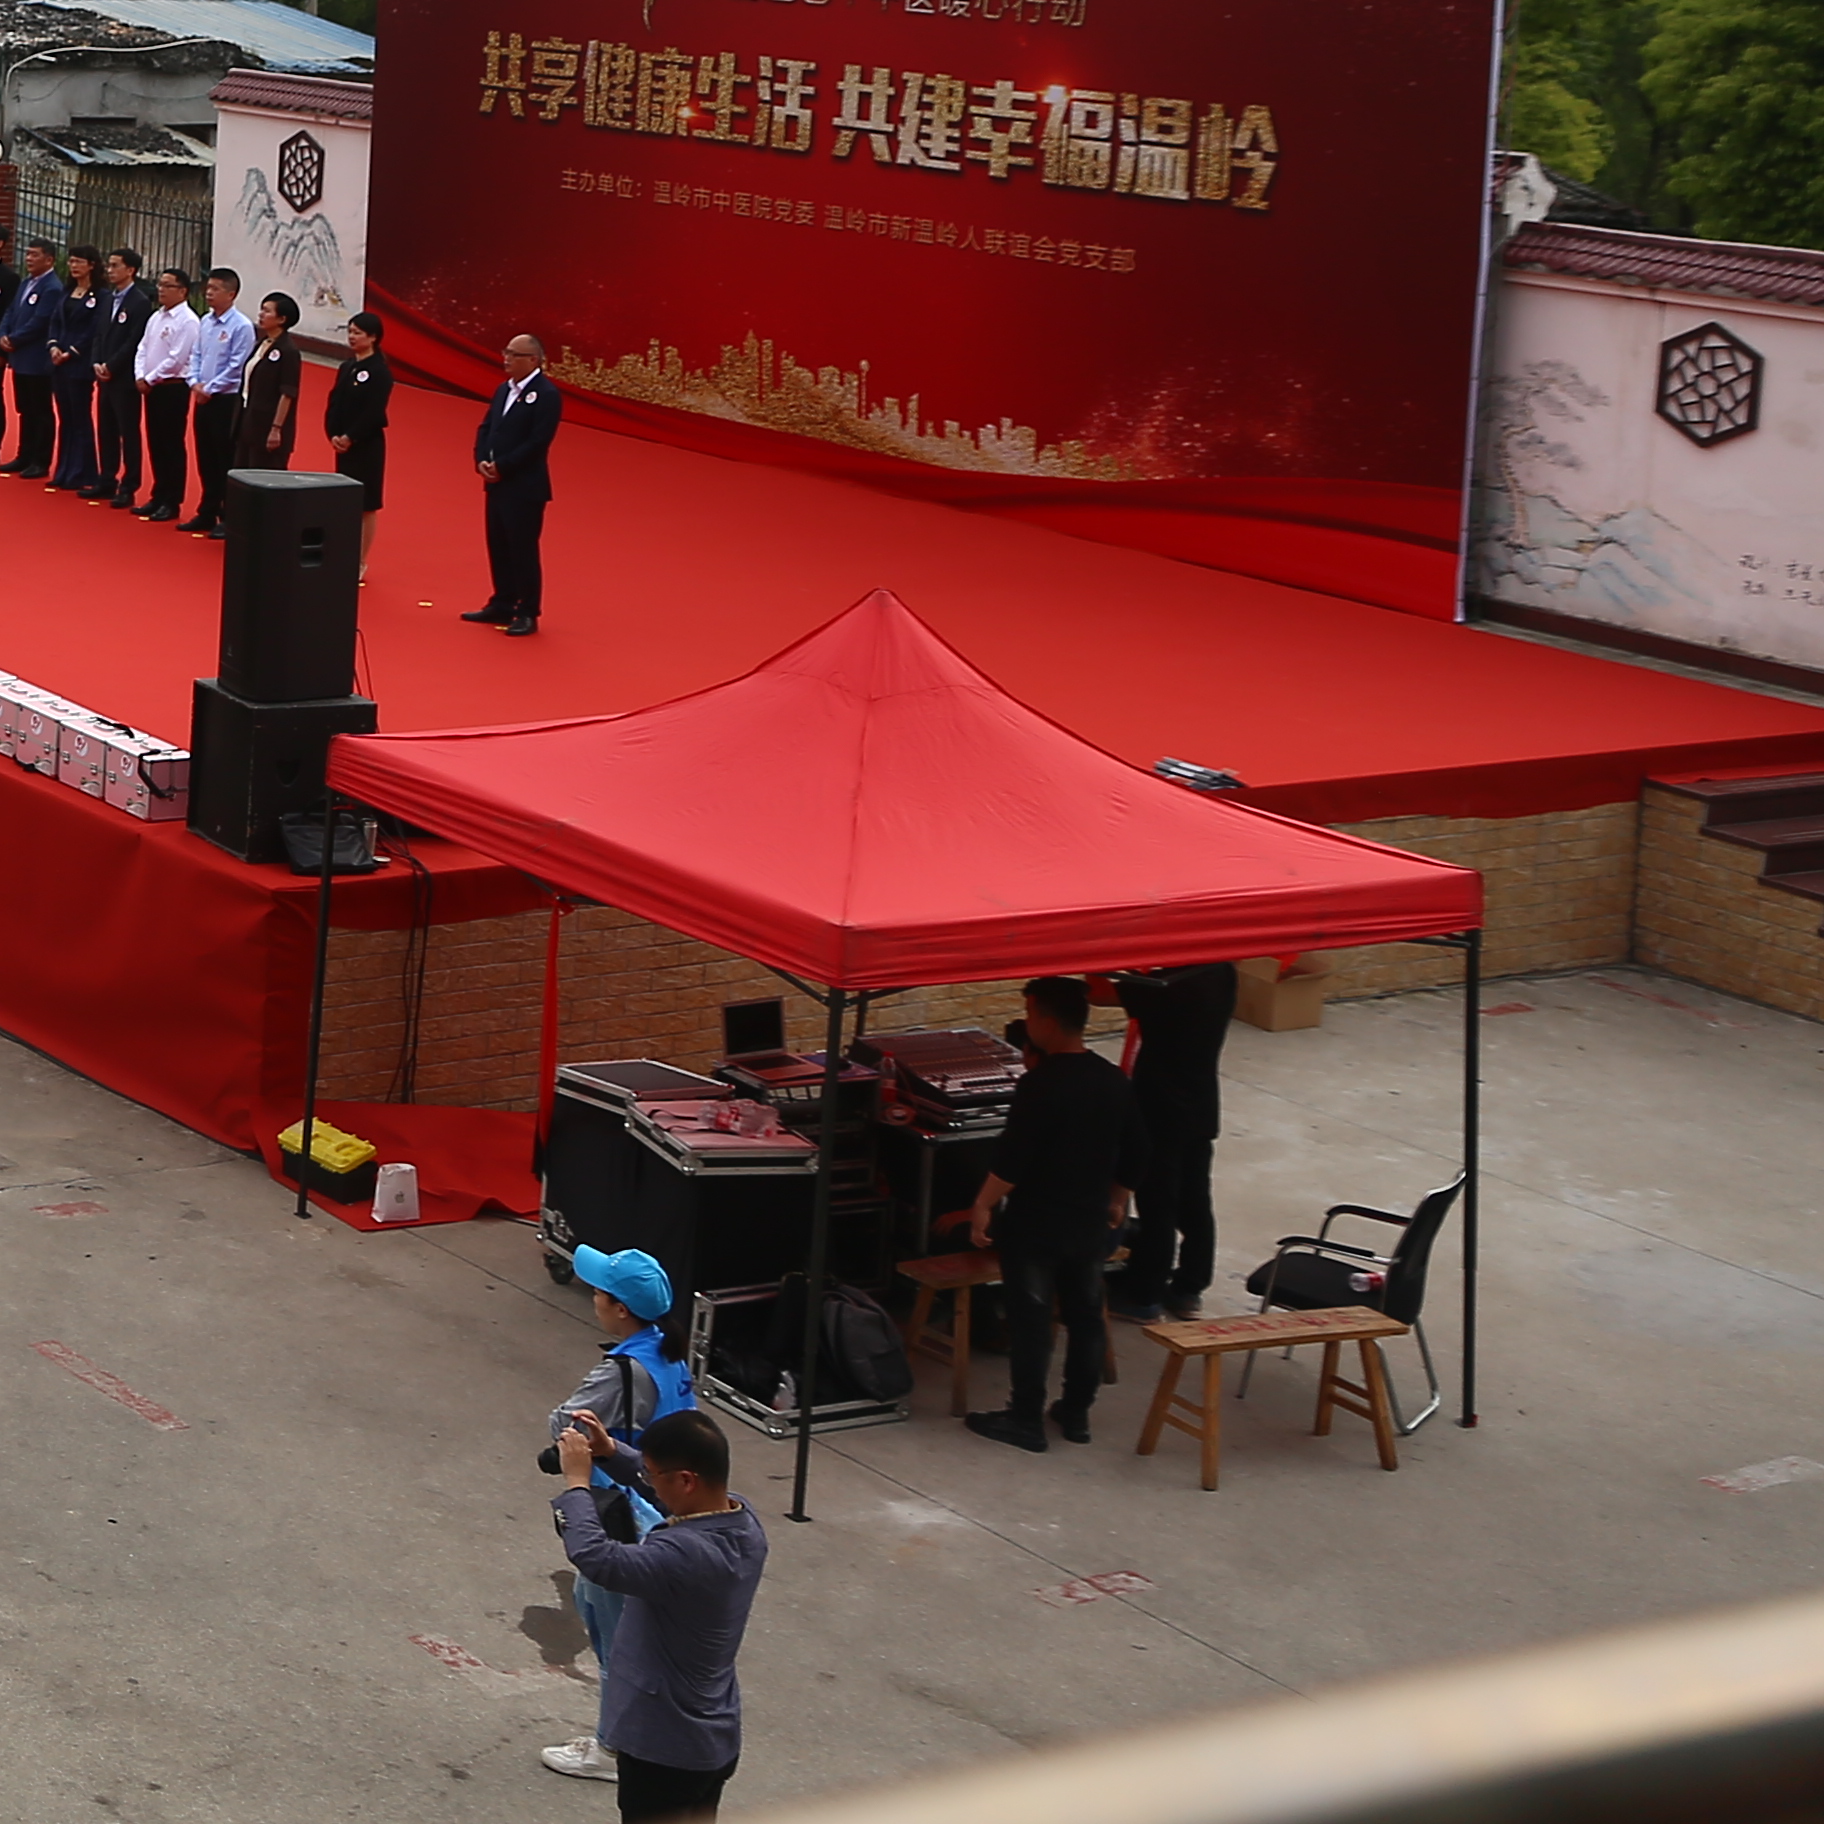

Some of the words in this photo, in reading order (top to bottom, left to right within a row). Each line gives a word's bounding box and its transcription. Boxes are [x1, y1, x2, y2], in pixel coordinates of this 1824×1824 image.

[478, 31, 817, 152] 共享健康生活
[831, 63, 1279, 210] 共建幸福温岭
[653, 180, 816, 226] 温岭市中医院党委
[824, 204, 1137, 275] 温岭市新温岭人联谊会党支部
